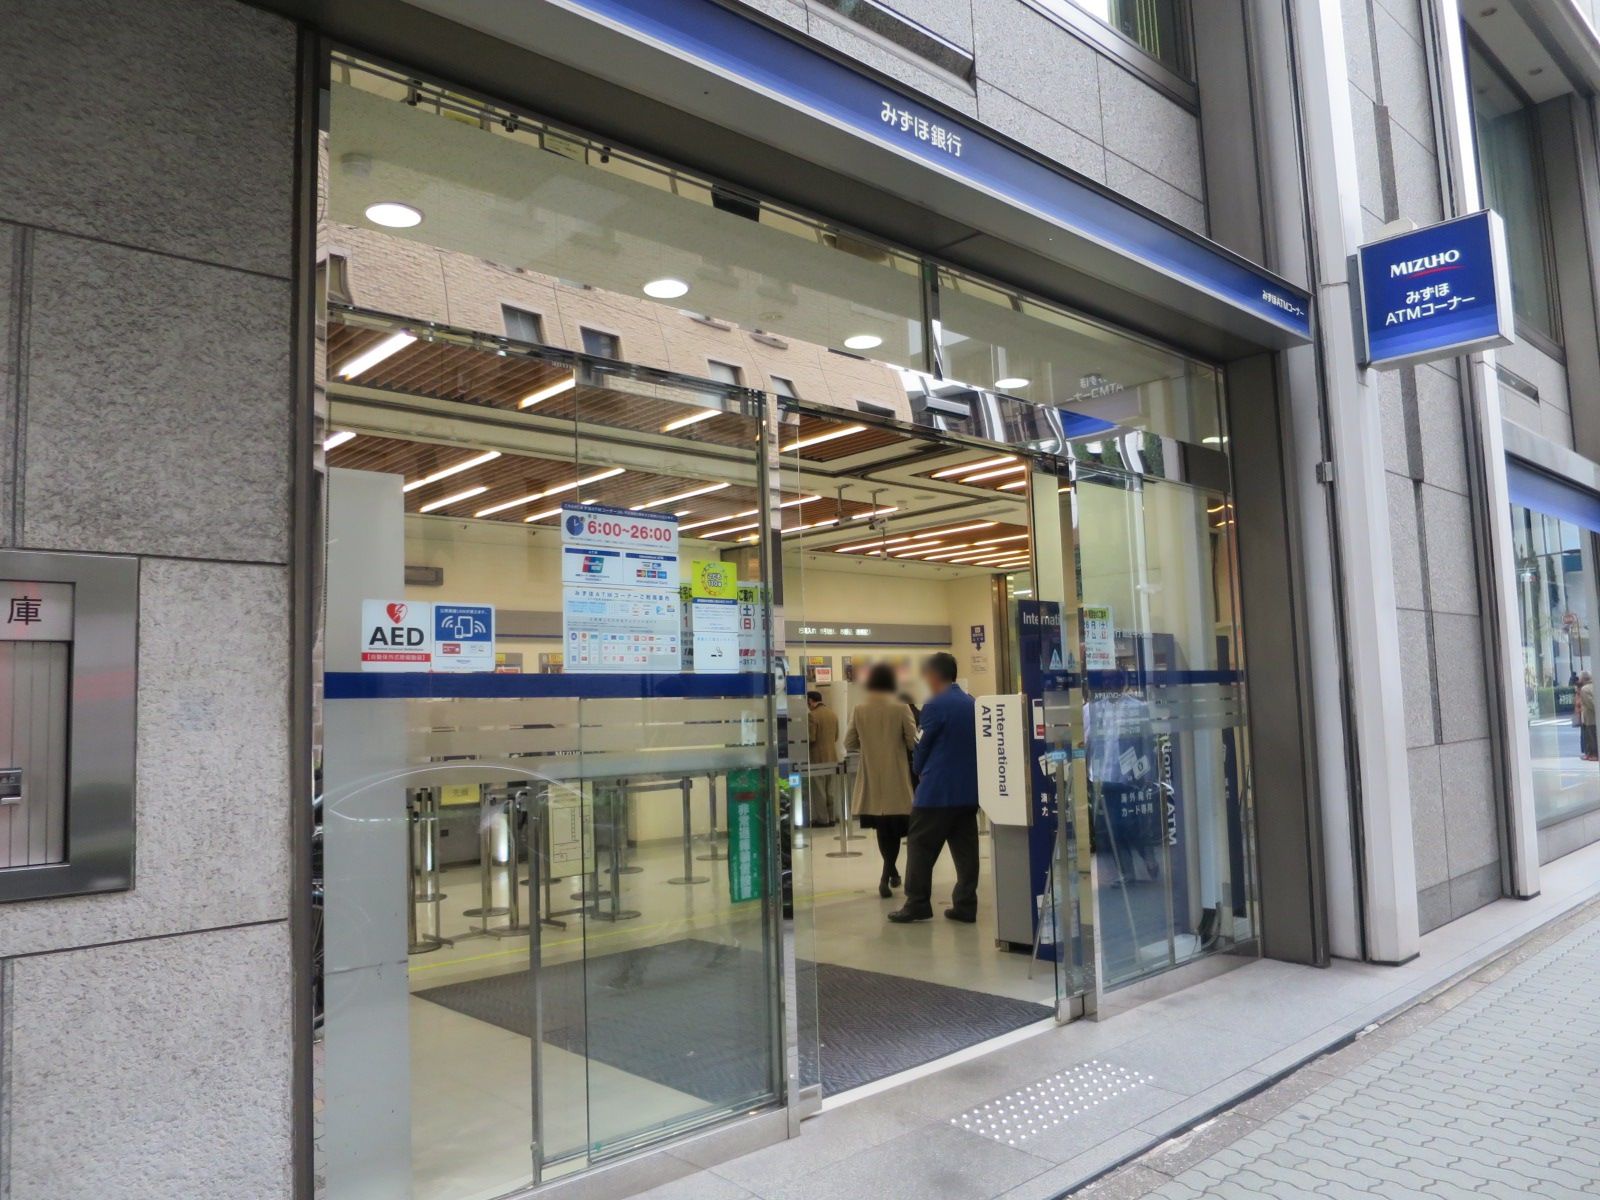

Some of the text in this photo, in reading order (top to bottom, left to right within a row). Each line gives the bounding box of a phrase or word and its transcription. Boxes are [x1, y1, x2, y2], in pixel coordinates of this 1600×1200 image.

[881, 101, 961, 157] みずほ銀行
[1390, 249, 1460, 278] MIZUHO
[1405, 282, 1450, 304] みずほ
[1385, 296, 1476, 326] ATMコーナー
[8, 596, 42, 626] 庫
[369, 626, 425, 647] AED
[981, 705, 992, 738] ATM
[996, 703, 1009, 797] International
[1166, 802, 1178, 845] ATM
